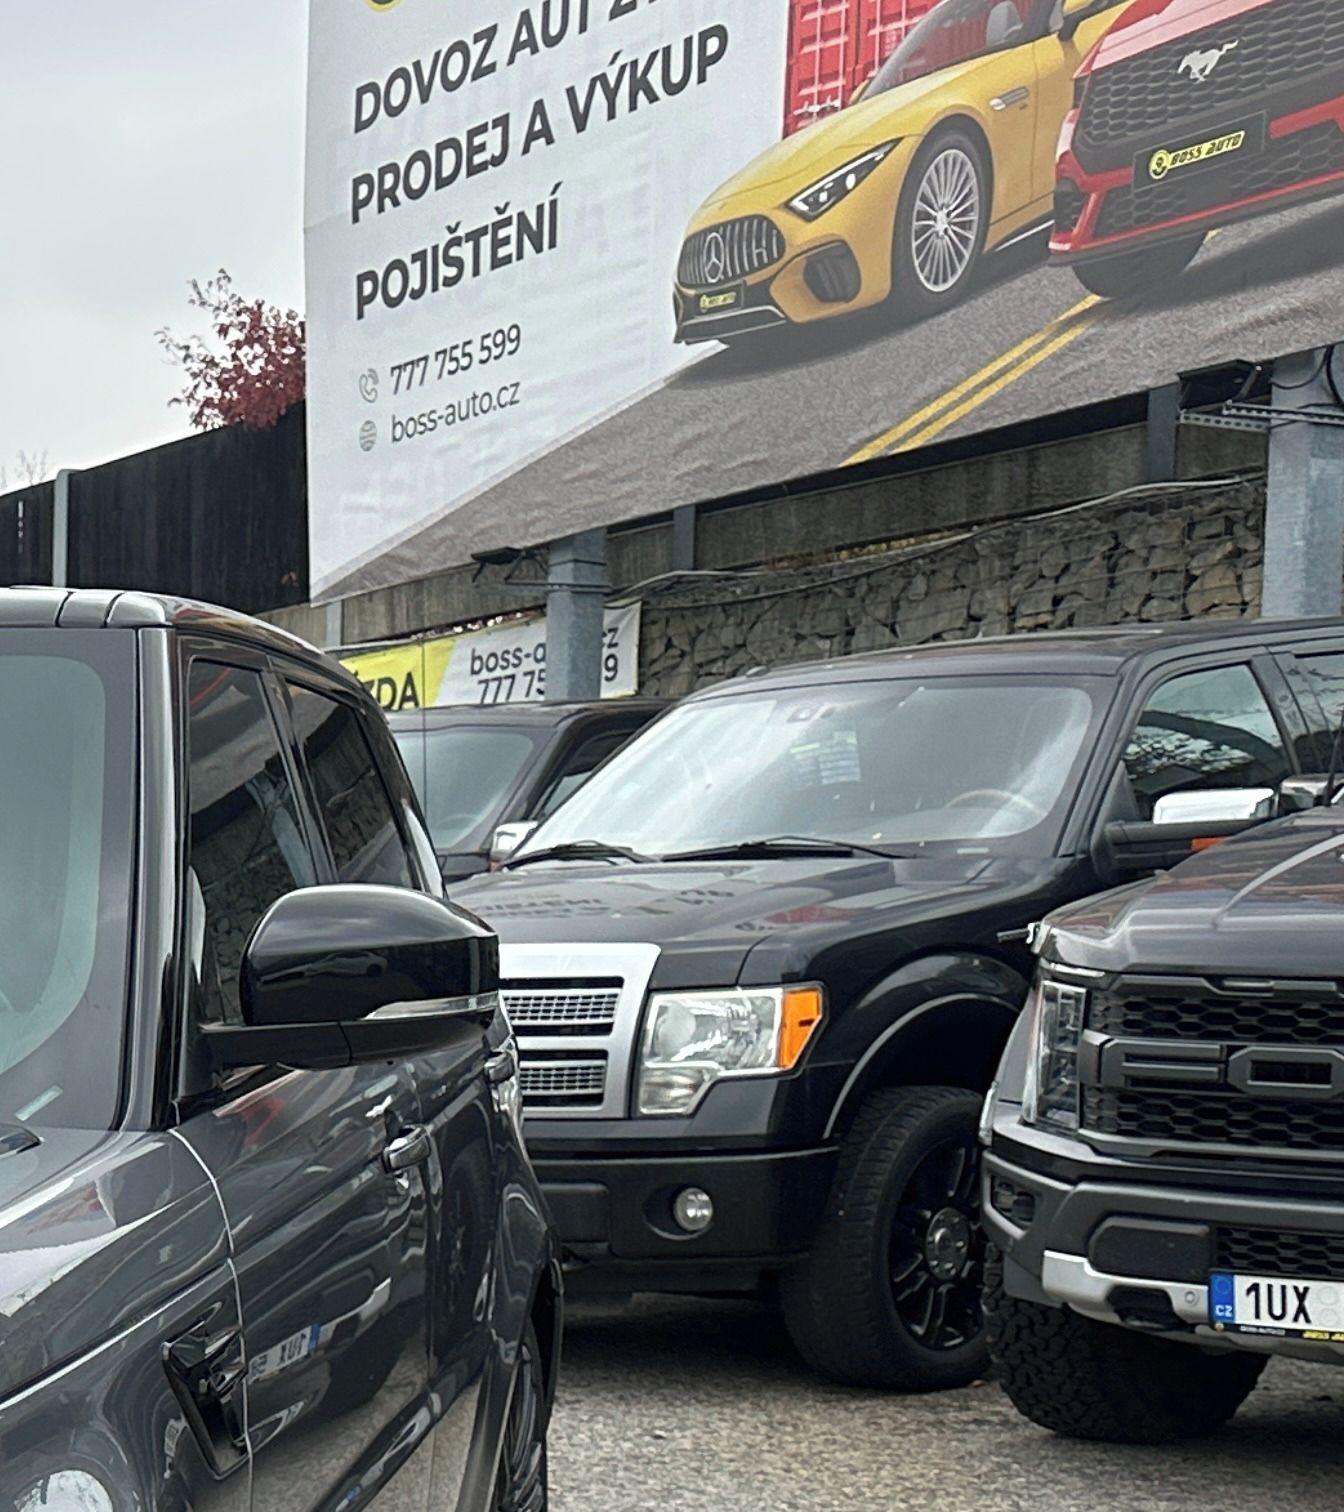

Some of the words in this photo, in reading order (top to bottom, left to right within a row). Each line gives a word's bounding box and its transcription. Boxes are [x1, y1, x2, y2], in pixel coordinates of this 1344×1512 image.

[354, 23, 498, 134] DOVOZ
[351, 112, 511, 224] PRODEJ
[521, 99, 555, 156] A
[565, 24, 729, 134] VÝKUP
[1171, 146, 1202, 165] BOSS
[356, 181, 563, 320] POJIŠTĚNÍ
[390, 355, 429, 395] 777
[434, 340, 473, 380] 755
[478, 323, 521, 366] 599
[391, 381, 521, 444] boss-auto.cz
[1215, 1304, 1233, 1318] CZ
[1246, 1282, 1311, 1324] 1UX
